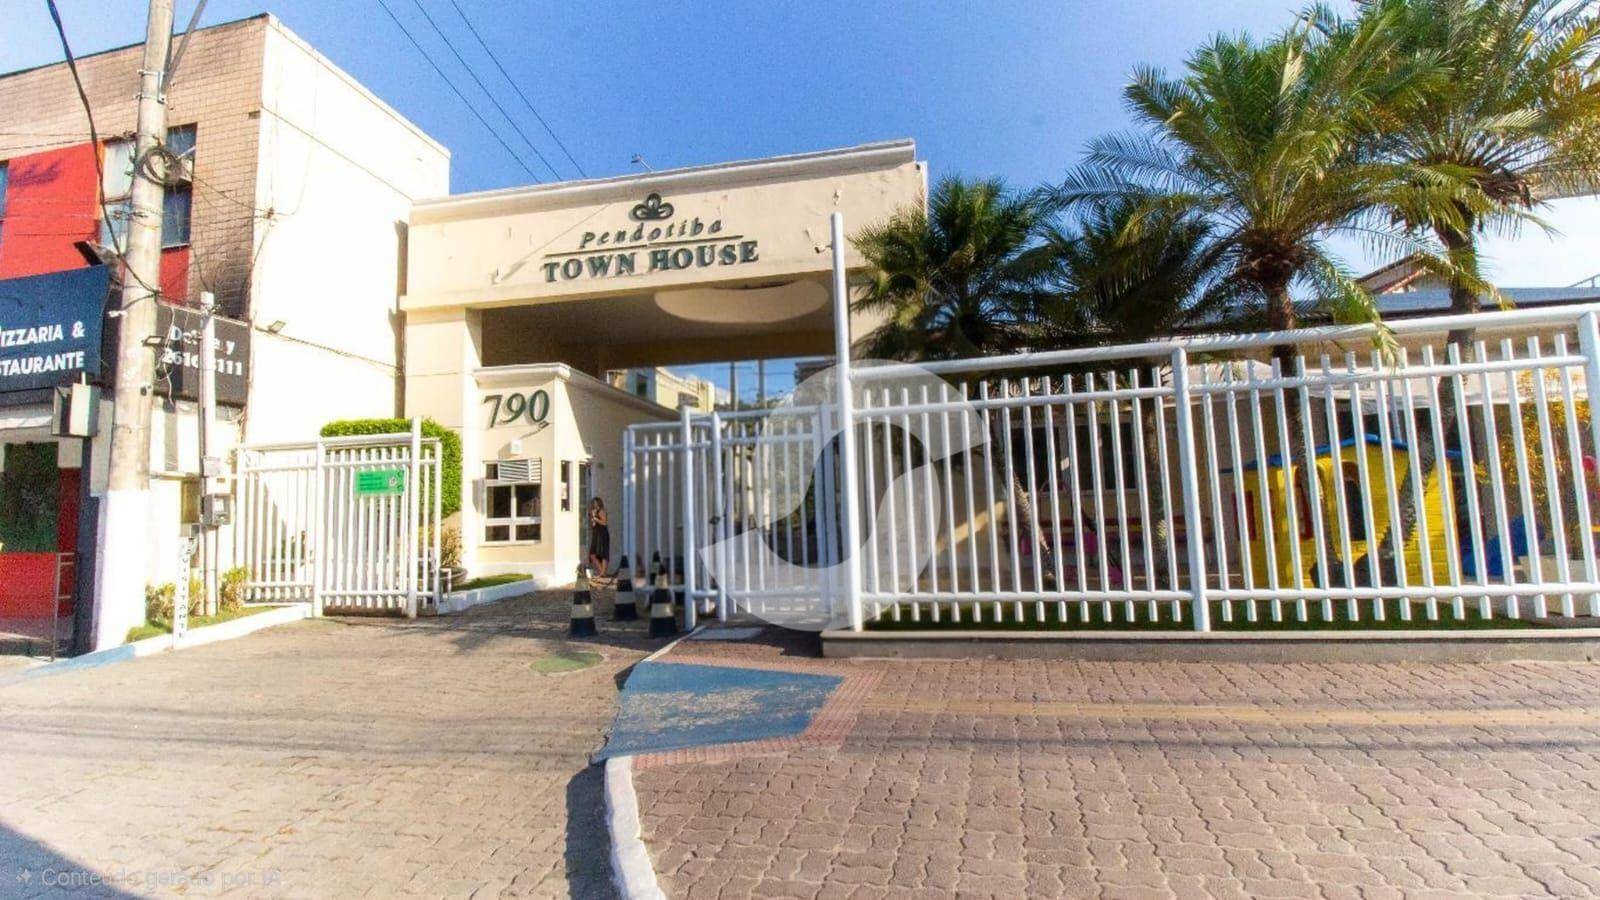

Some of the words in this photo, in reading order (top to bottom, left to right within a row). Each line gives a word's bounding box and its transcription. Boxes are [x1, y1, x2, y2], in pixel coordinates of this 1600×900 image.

[541, 252, 636, 282] TOWN
[648, 240, 759, 273] HOUSE
[0, 324, 64, 347] IZZARIA
[72, 321, 85, 338] &
[0, 351, 85, 376] TAURANTE
[484, 389, 550, 429] 790
